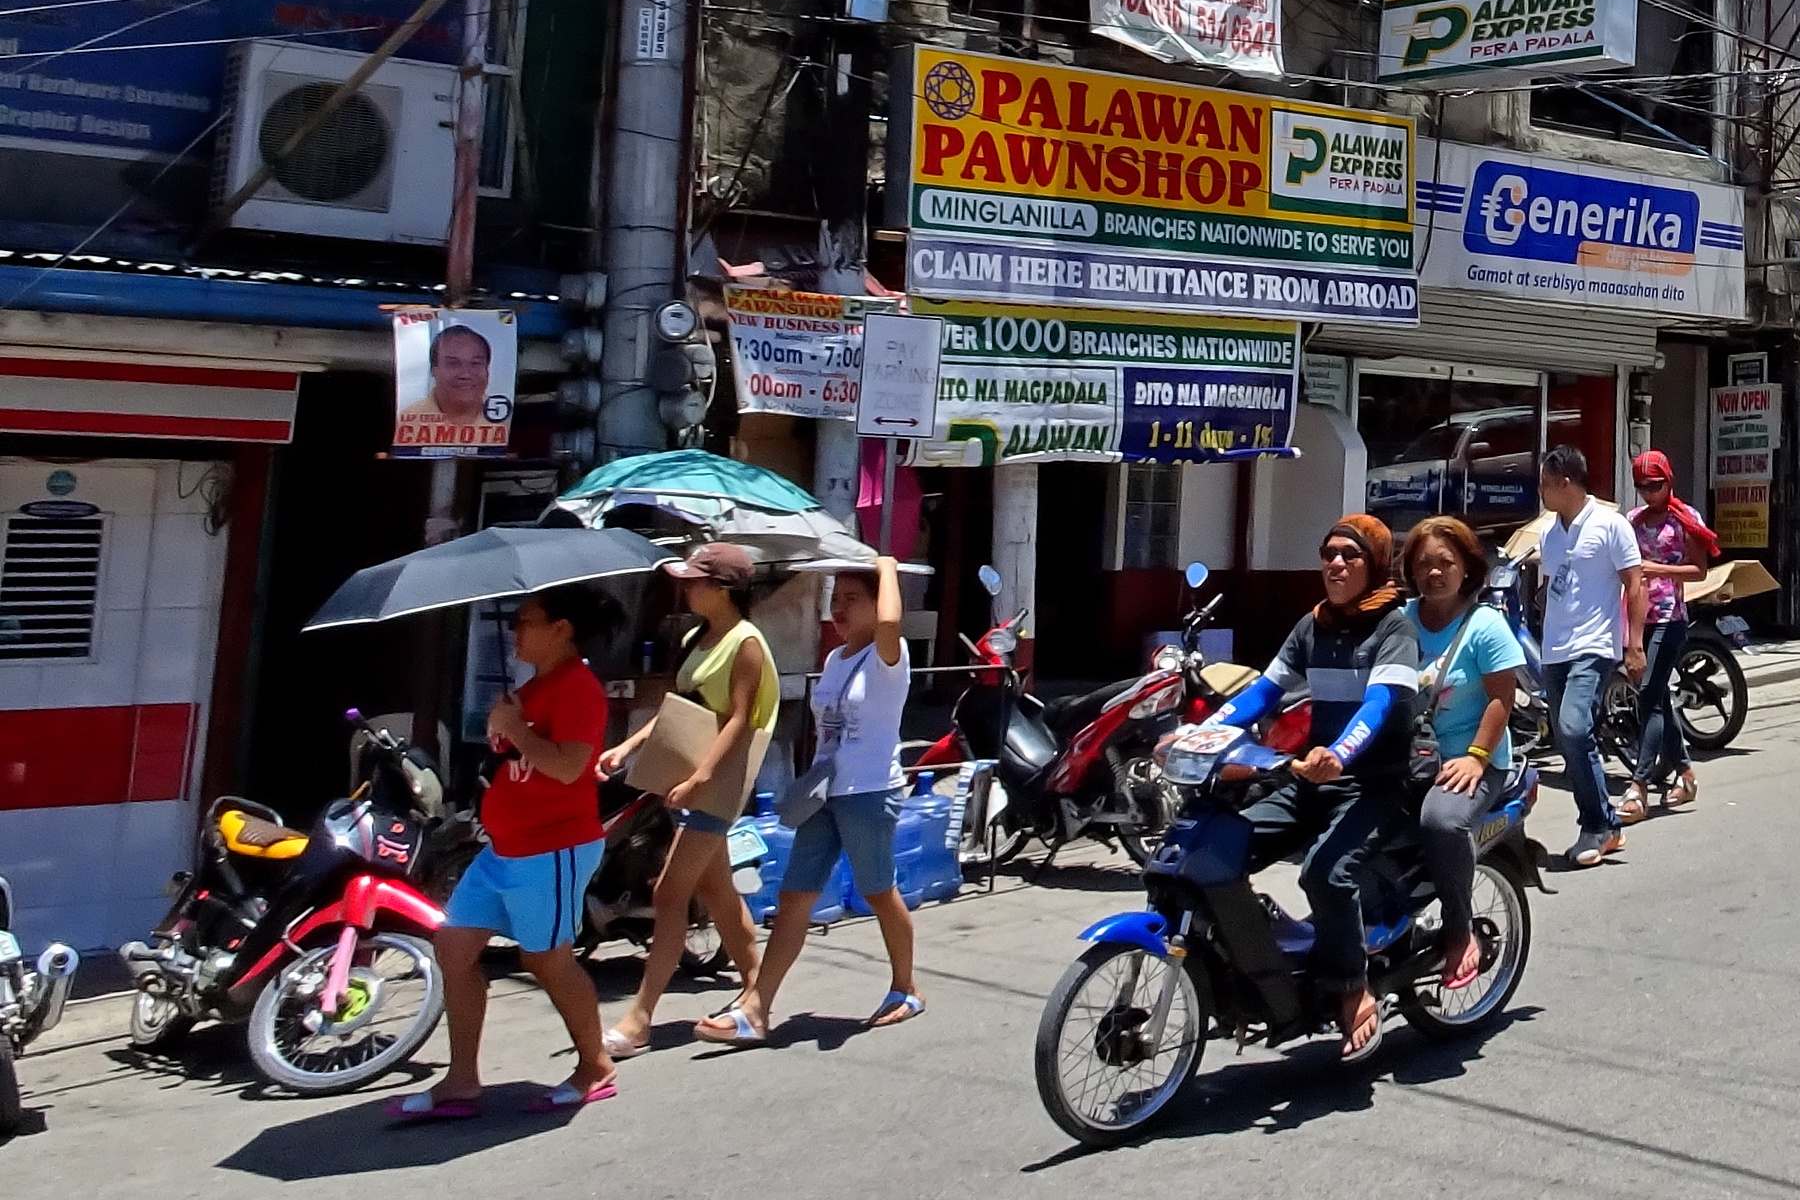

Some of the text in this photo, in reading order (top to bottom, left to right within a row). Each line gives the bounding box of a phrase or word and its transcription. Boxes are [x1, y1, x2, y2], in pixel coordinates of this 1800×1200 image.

[1470, 7, 1597, 43] EXPRESS
[1469, 29, 1596, 60] PERA PADALA
[979, 69, 1264, 155] PALAWAN
[920, 123, 1263, 208] PAWNSHOP
[1329, 155, 1404, 181] EXPRESS
[1329, 177, 1404, 196] PERA PADALA
[931, 194, 1410, 259] MINGLANILLA BRANCHES NATIONWIDE TO SERVE YOU
[912, 248, 1417, 311] CLAIM HERE REMITTANCE FROM ABROAD
[1466, 263, 1686, 302] Gamot at serbisyo maaasahan dito
[727, 311, 759, 329] NEW
[763, 316, 840, 336] BUSINESS
[980, 315, 1067, 354] 1000
[1068, 329, 1178, 360] BRANCHES
[1181, 335, 1293, 365] NATIONWIDE
[939, 377, 1108, 406] ITO NA MAGPADALA
[1134, 381, 1286, 411] DITO NA MAGSANGLA
[1716, 389, 1771, 414] NOW OPEN!
[396, 425, 508, 445] CAMOTA
